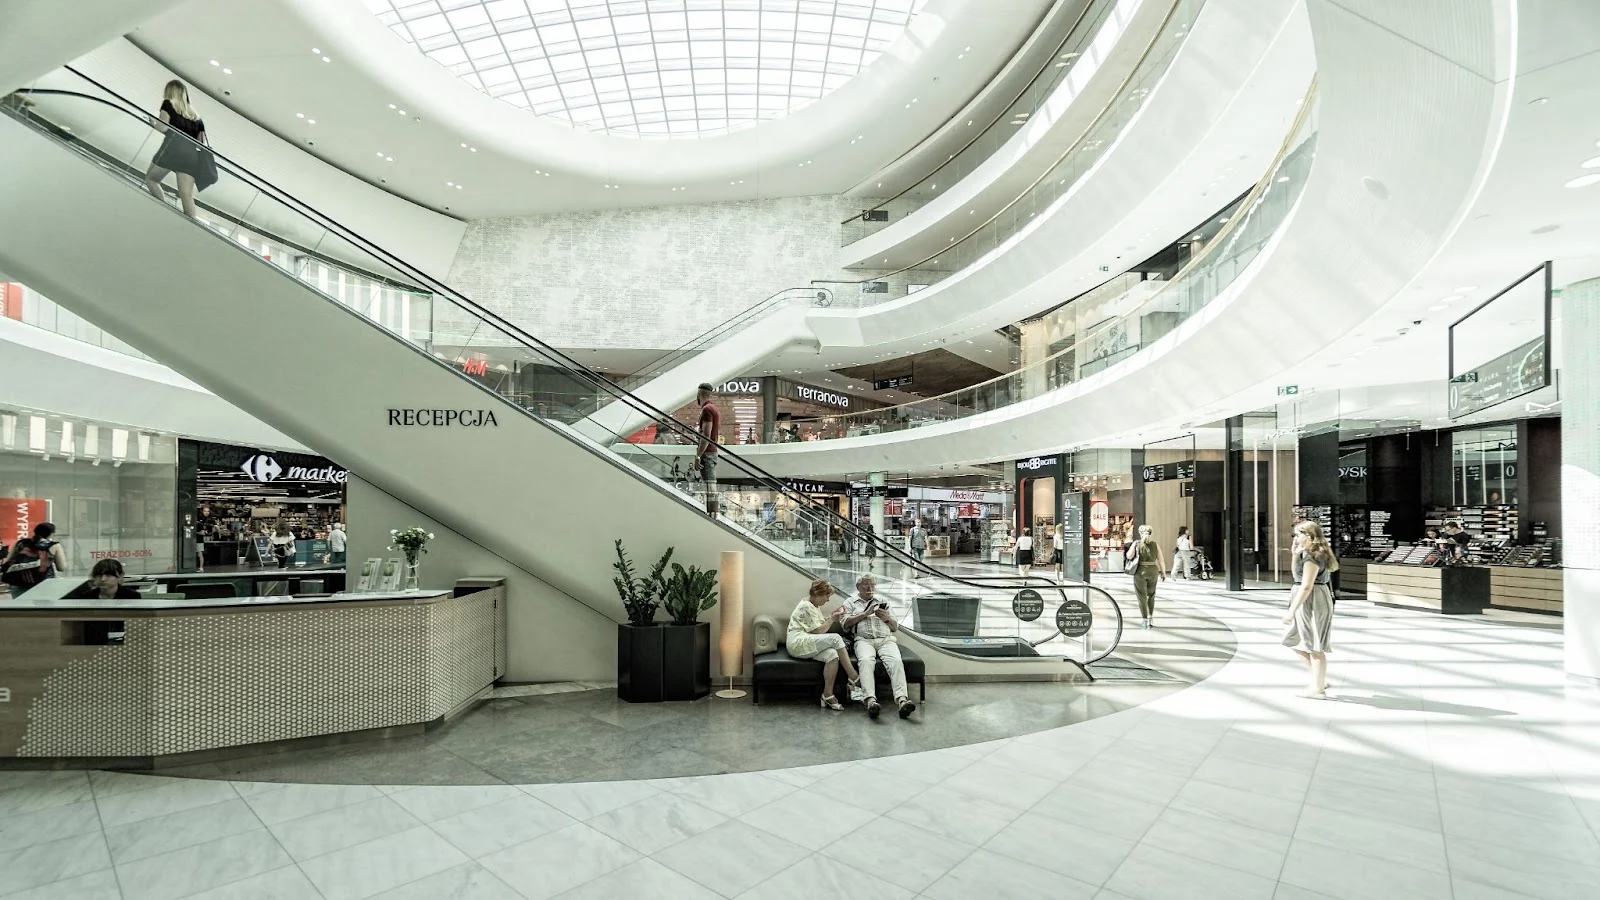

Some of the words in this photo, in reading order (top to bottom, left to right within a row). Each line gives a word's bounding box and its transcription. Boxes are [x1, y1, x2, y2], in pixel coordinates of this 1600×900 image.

[463, 357, 488, 377] H&M
[797, 385, 849, 407] Terranova
[387, 409, 498, 427] RECEPCJA
[1092, 513, 1107, 521] SALE
[90, 550, 118, 559] TERAZ
